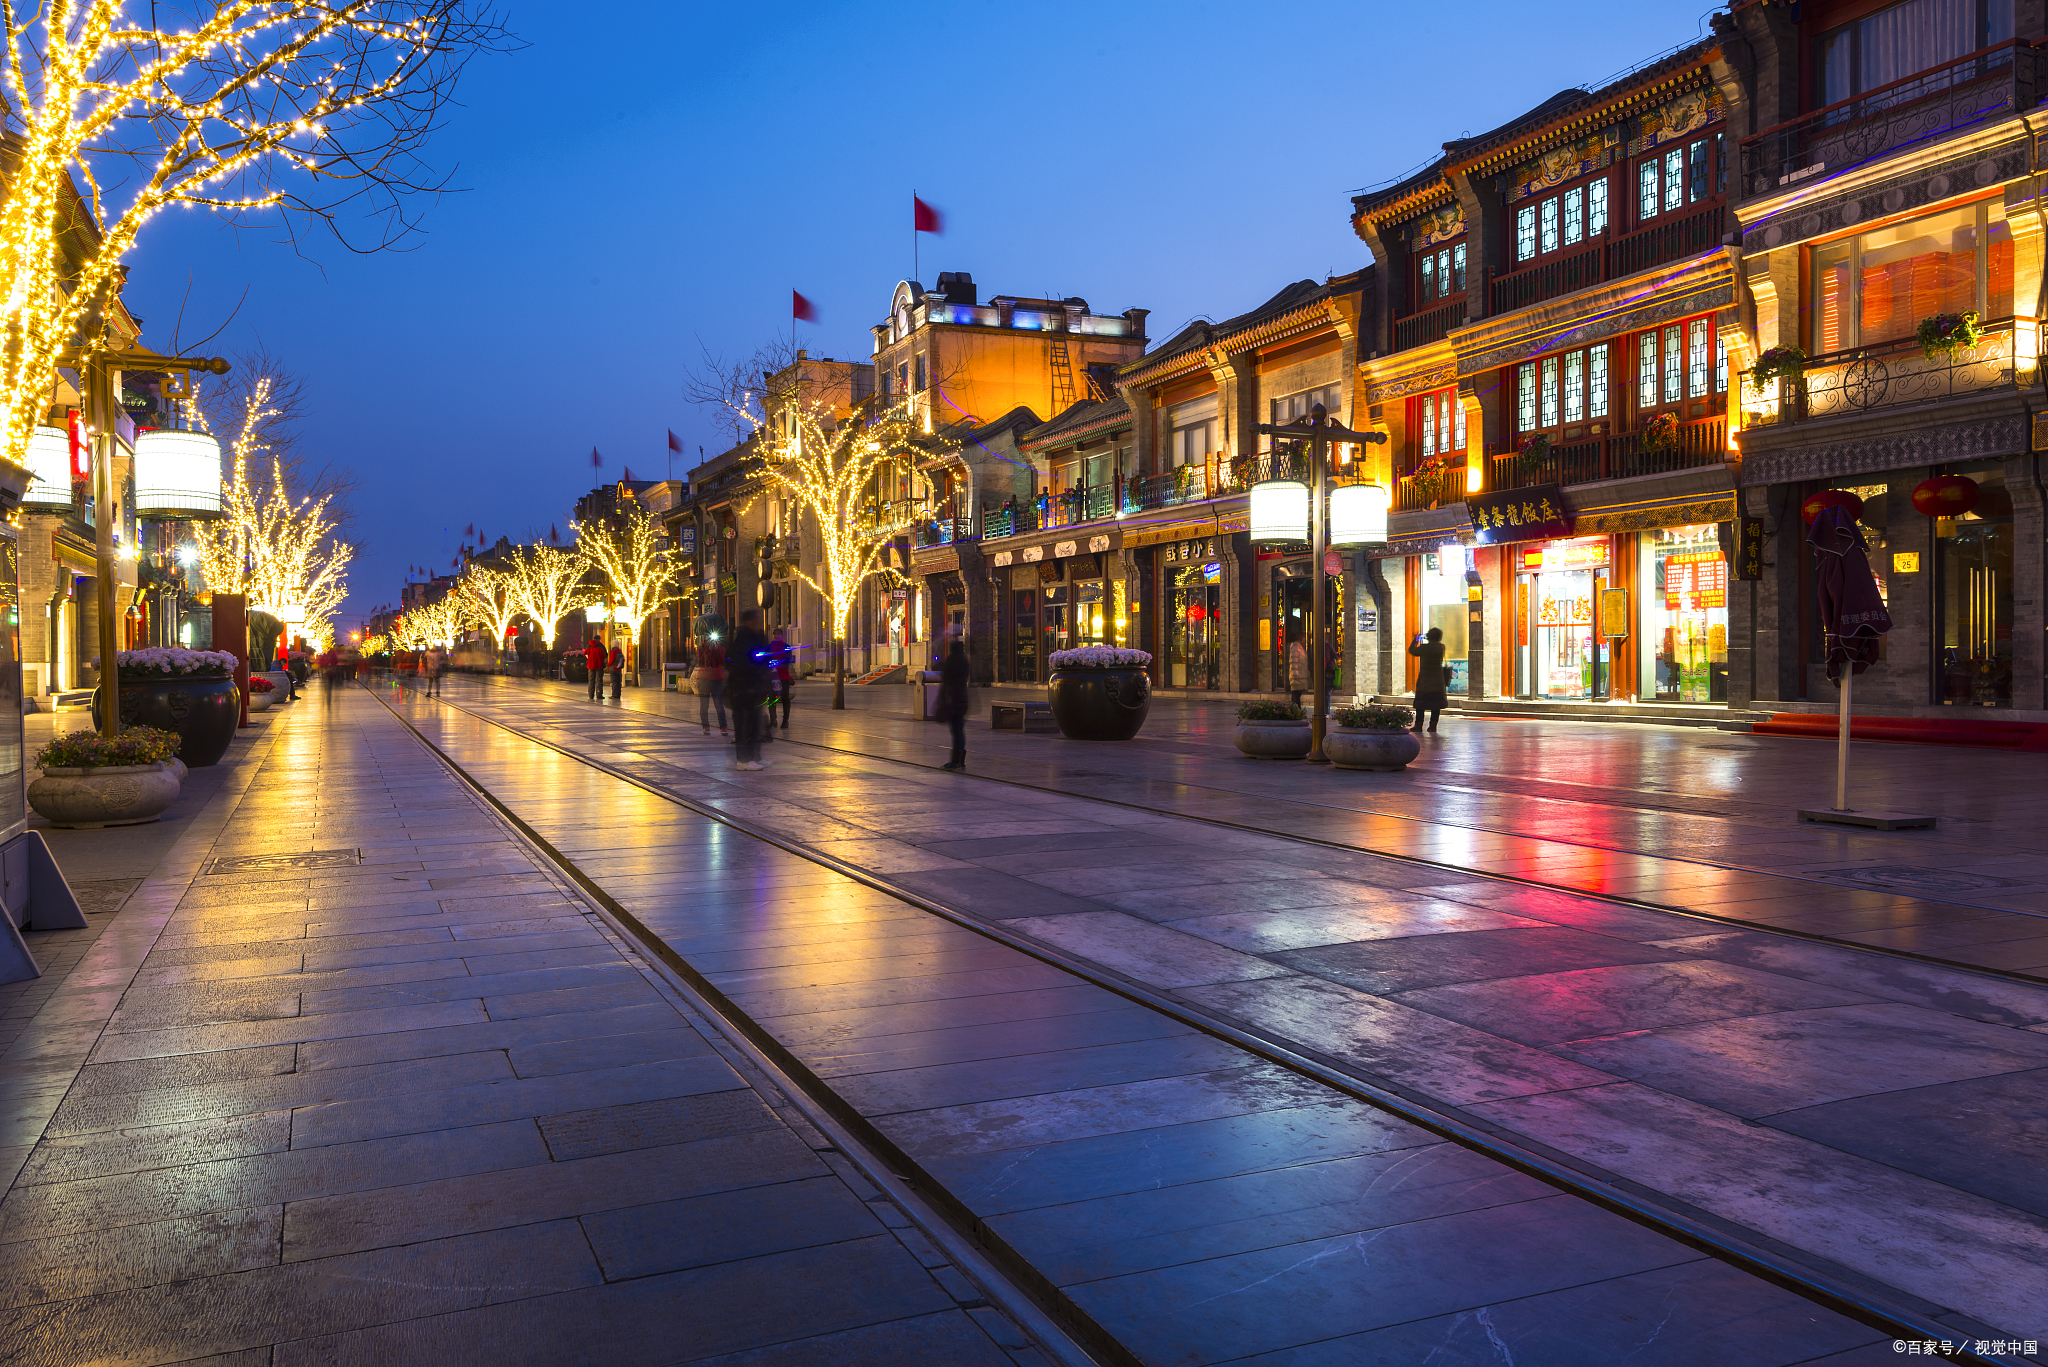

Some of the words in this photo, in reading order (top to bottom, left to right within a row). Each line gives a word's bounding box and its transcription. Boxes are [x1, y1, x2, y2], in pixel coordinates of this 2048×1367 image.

[683, 528, 695, 554] 药店
[1745, 522, 1761, 577] 稻香村
[1902, 560, 1911, 570] 25
[1841, 610, 1887, 625] 管理委员会
